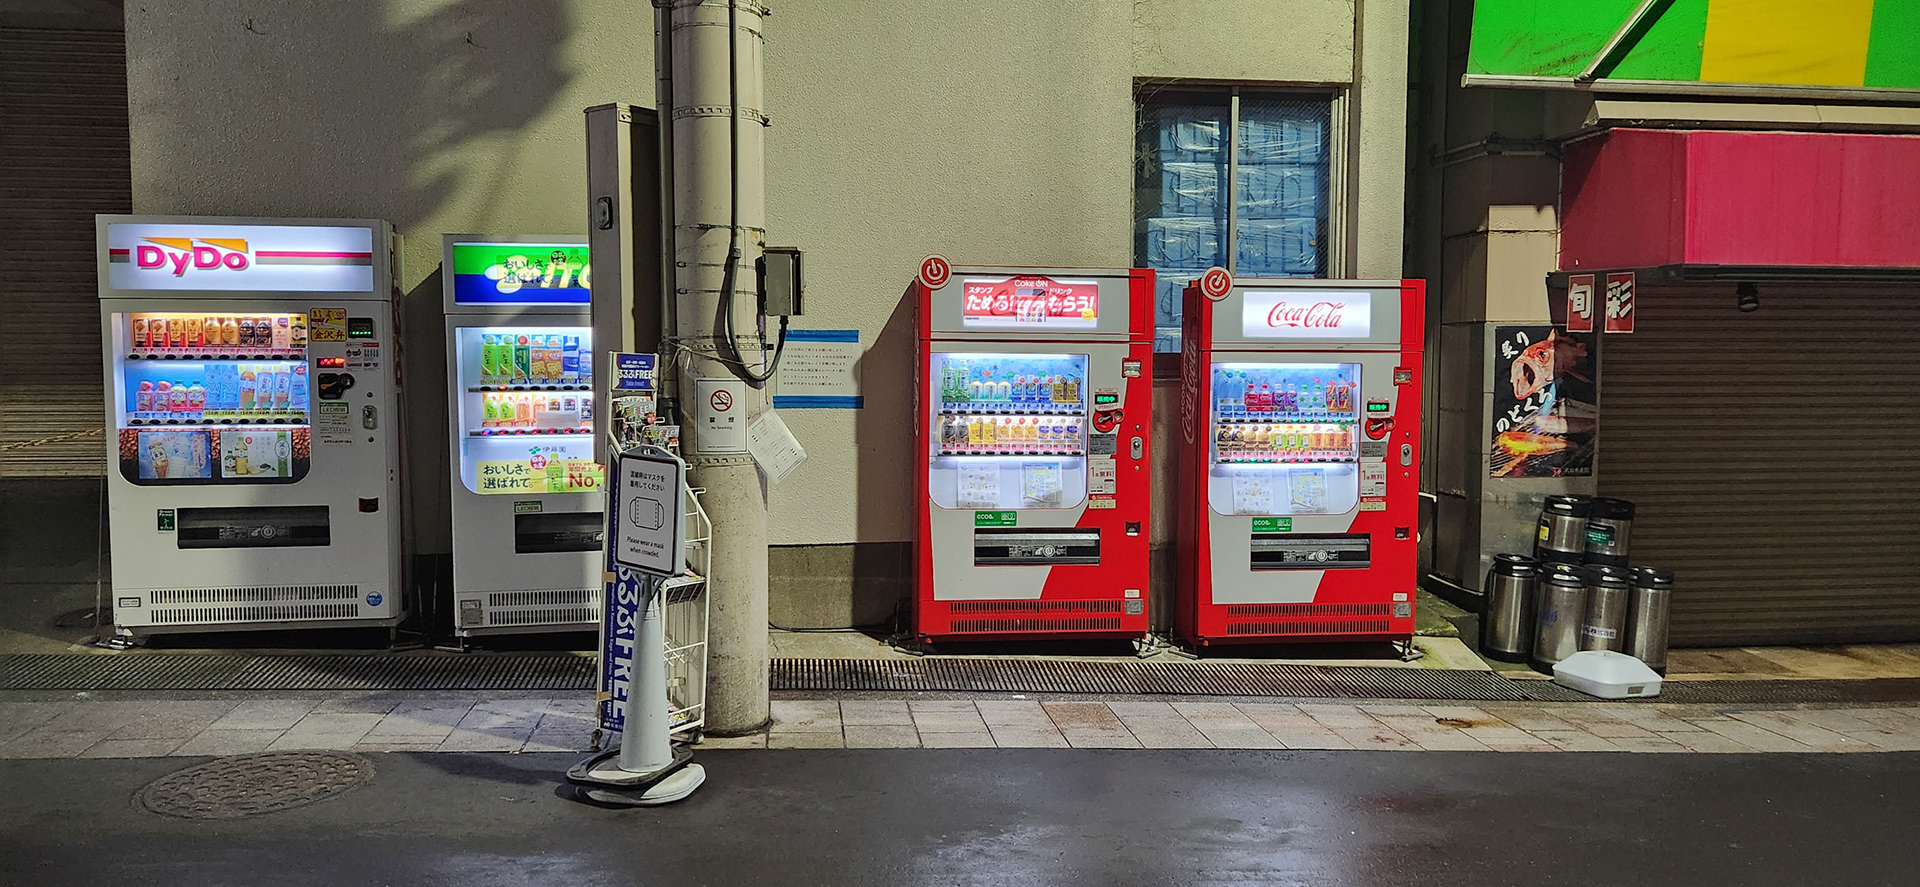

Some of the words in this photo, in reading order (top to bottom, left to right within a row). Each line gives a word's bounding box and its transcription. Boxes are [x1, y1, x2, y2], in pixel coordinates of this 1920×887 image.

[137, 245, 248, 276] DyDo
[504, 258, 552, 270] おいしさで
[503, 272, 554, 284] 選ばれて。
[1036, 279, 1048, 287] ON
[967, 286, 993, 294] スタンプ
[1049, 287, 1073, 295] ドリンク
[1570, 283, 1592, 319] 旬
[1606, 280, 1633, 319] 彩
[1267, 301, 1346, 328] Coca-Cola
[313, 329, 345, 340] 金沢弁
[483, 464, 530, 475] おいしさで
[483, 477, 533, 489] 選ばれて。
[627, 536, 639, 544] Please
